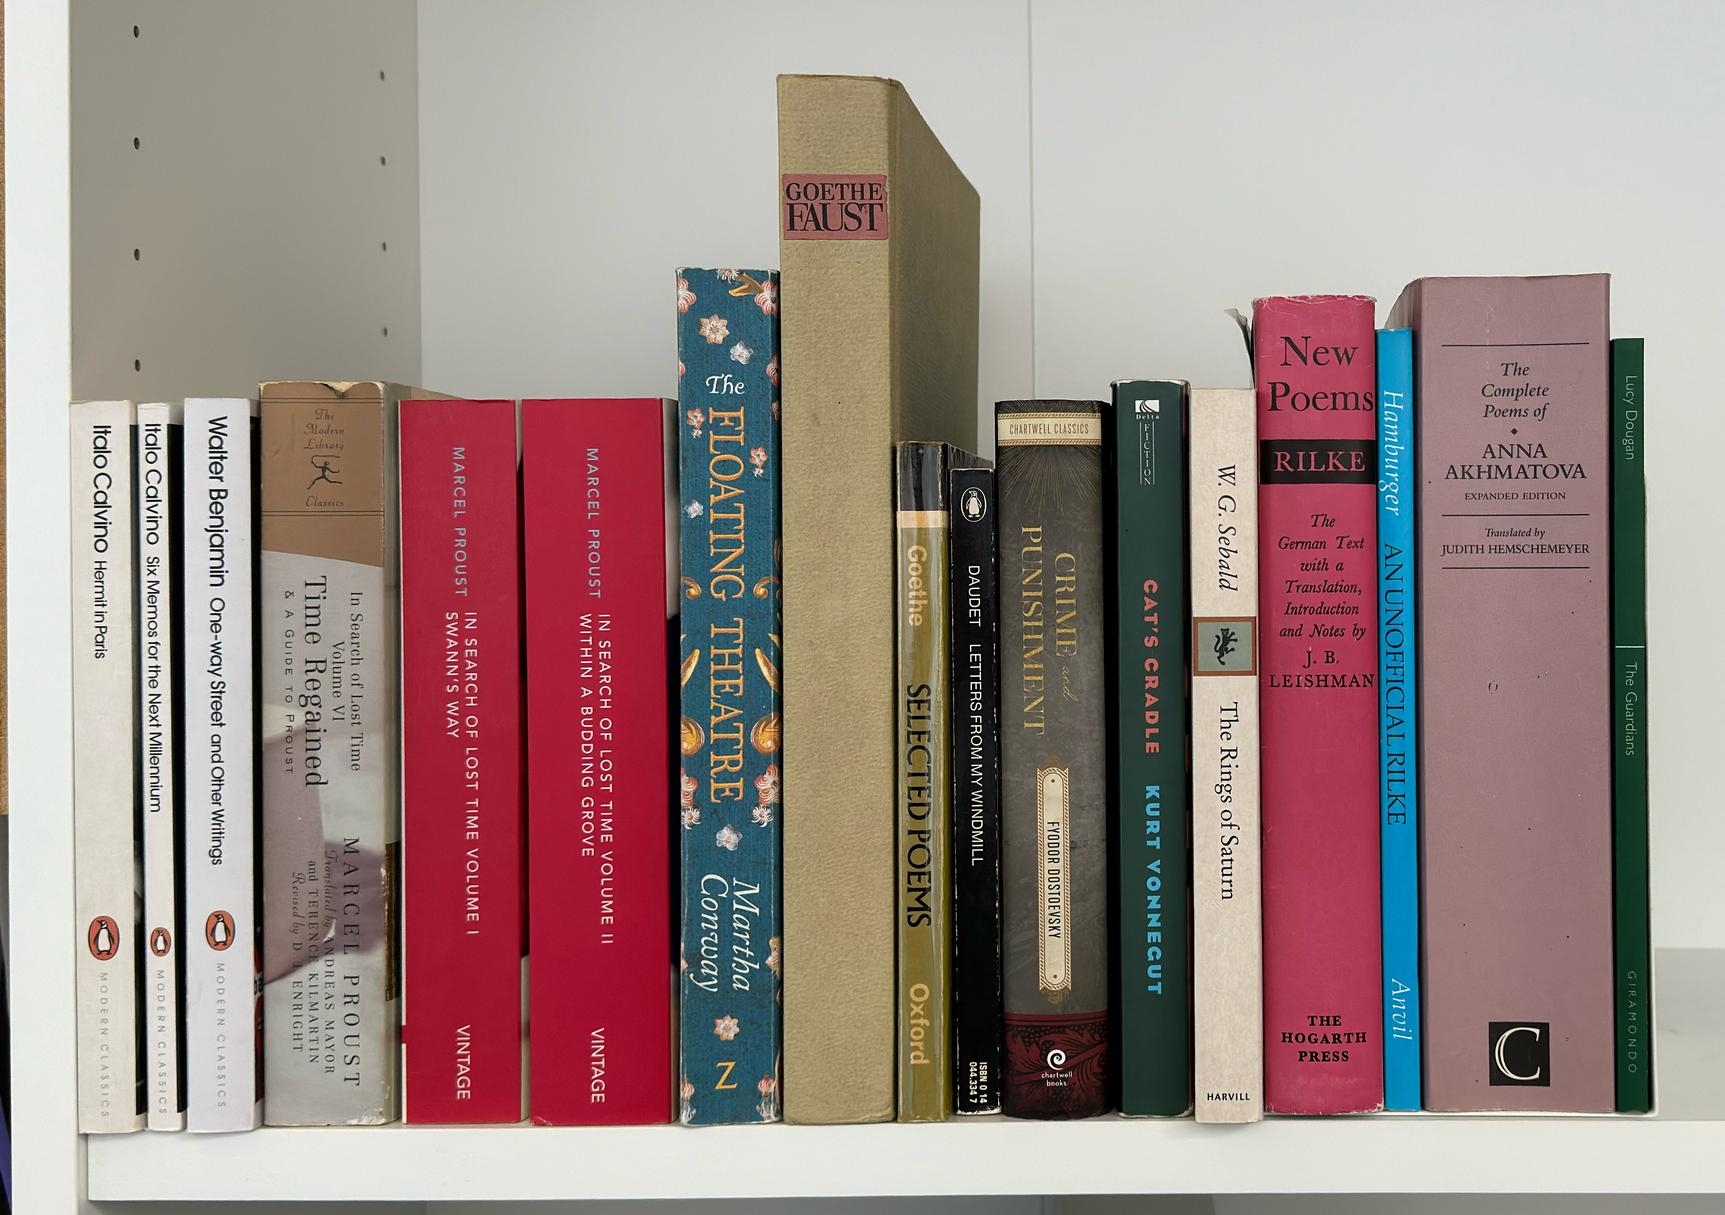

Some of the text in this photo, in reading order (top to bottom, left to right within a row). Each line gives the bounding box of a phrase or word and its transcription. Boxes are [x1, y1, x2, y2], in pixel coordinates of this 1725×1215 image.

[785, 183, 882, 201] GOETHE
[786, 202, 883, 231] FAUST
[705, 375, 745, 395] The
[1280, 336, 1359, 367] New
[1500, 362, 1529, 376] The
[1267, 381, 1374, 412] Poems
[1481, 384, 1549, 401] Complete
[1483, 403, 1549, 421] Poems of
[1623, 375, 1638, 460] Lucy Dougan
[1009, 423, 1089, 435] CHARTWELL CLASSICS
[1274, 451, 1366, 473] RILKE
[1378, 390, 1405, 515] Hamburger
[1482, 444, 1547, 459] ANNA
[1445, 464, 1587, 480] AKHMATOVA
[1523, 492, 1566, 500] EDITION
[93, 425, 112, 659] Italo Calvino Hermit in Paris
[452, 447, 467, 597] MARCEL PROUST
[586, 448, 600, 598] MARCEL PROUST
[1217, 464, 1238, 591] W. G. Sebald
[1278, 536, 1365, 551] German Text
[1311, 513, 1336, 528] The
[1441, 544, 1590, 557] JUDITH HEMSCHEMEYER
[1485, 528, 1545, 539] Translated by
[907, 545, 928, 626] Goethe
[968, 566, 981, 627] DAUDET
[1285, 580, 1362, 596] Translation,
[1300, 558, 1344, 573] with a
[144, 423, 163, 812] Italo Calvino Six Memos for the Next Millennium
[464, 612, 478, 629] IN
[707, 406, 745, 803] FLOATING THEATRE
[1021, 526, 1045, 735] PUNISHMENT
[1054, 552, 1080, 702] CRIME and
[1280, 624, 1366, 640] and Notes by
[1284, 602, 1360, 616] Introduction
[205, 416, 228, 865] Walter Benjamin One-way Street and Other Writings
[445, 612, 459, 738] SWANN'S WAY
[465, 639, 478, 706] SEARCH
[1143, 579, 1160, 753] CAT'S CRADLE
[1303, 650, 1340, 670] J. B.
[300, 576, 328, 787] Time Regained
[332, 641, 345, 721] Volume VI
[350, 592, 364, 771] In Search of Lost Time
[1270, 673, 1375, 688] LEISHMAN
[1384, 543, 1406, 825] AN UNOFFICIAL RILKE
[1624, 663, 1638, 756] The Guardians
[466, 715, 478, 738] OF
[579, 614, 594, 857] WITHIN A BUDDING GROVE
[969, 644, 984, 866] LETTERS FROM MY WINDMILL
[465, 747, 478, 790] LOST
[598, 614, 614, 944] IN SEARCH OF LOST TIME VOLUME II
[1215, 702, 1240, 901] The Rings of Saturn
[466, 799, 479, 840] TIME
[906, 684, 932, 928] SELECTED POEMS
[466, 848, 479, 922] VOLUME
[1047, 821, 1061, 939] FYODOR DOSTOEVSKY
[1145, 785, 1162, 995] KURT VONNEGUT
[343, 837, 361, 1087] MARCEL PROUST
[690, 874, 729, 992] Conway
[731, 877, 760, 991] Martha
[156, 970, 168, 1114] MODERN CLASSICS
[216, 962, 227, 1108] MODERN CLASSICS
[909, 983, 931, 1065] Oxford
[1282, 1032, 1367, 1043] HOGARTH
[1307, 1015, 1342, 1027] THE
[1391, 978, 1411, 1040] Anvil
[1628, 971, 1636, 1073] GIRAMONDO
[100, 972, 111, 1118] MODERN CLASSICS
[456, 1025, 471, 1100] VINTAGE
[590, 1028, 606, 1104] VINTAGE
[979, 1061, 988, 1082] ISBN
[1298, 1050, 1350, 1063] PRESS
[1494, 1027, 1540, 1081] C
[979, 1094, 988, 1103] 14
[1207, 1091, 1251, 1102] HARVILL
